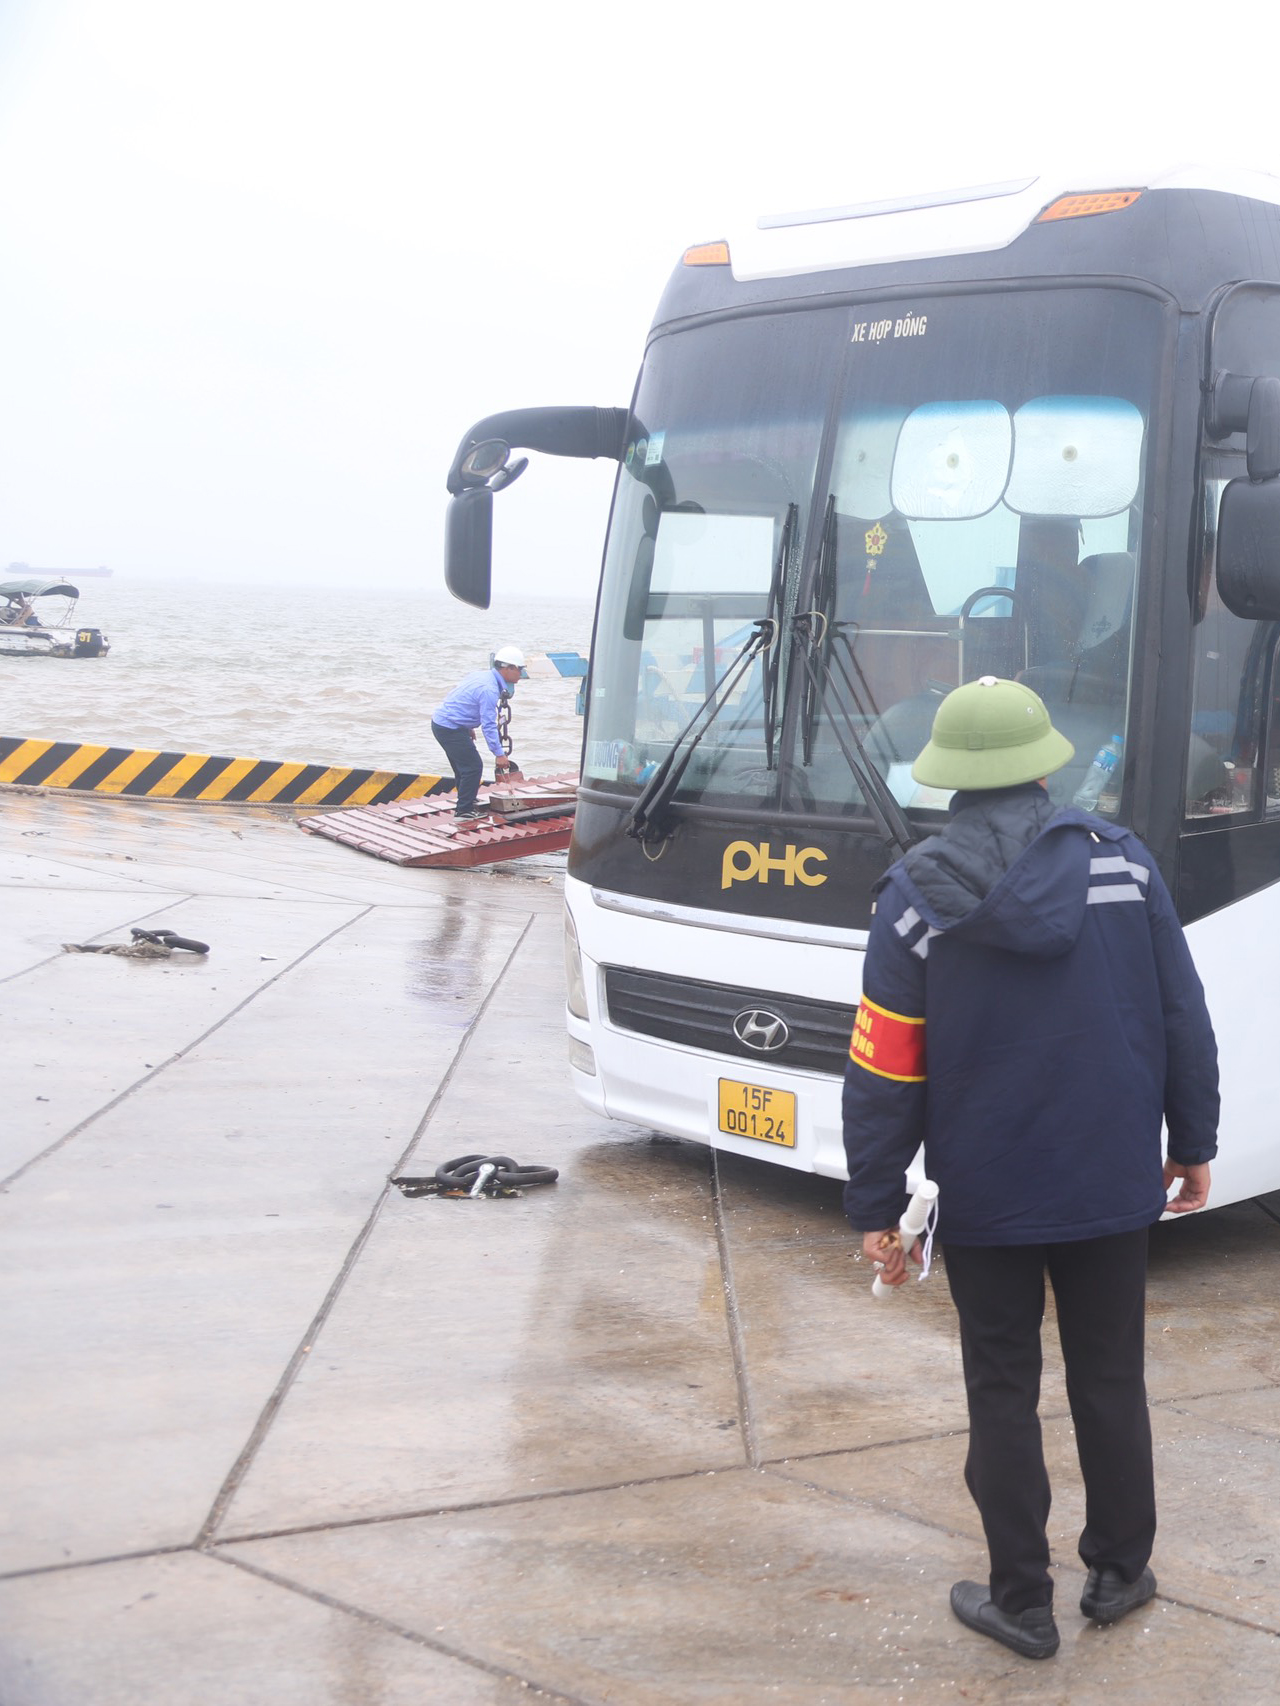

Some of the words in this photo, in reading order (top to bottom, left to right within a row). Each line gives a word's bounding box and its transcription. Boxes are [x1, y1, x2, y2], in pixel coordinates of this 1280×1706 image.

[851, 322, 867, 342] XE
[868, 318, 892, 345] HỢP
[894, 311, 927, 338] ĐỒNG
[721, 840, 828, 889] PHC
[742, 1086, 773, 1112] 15F
[727, 1108, 786, 1142] 001.24
